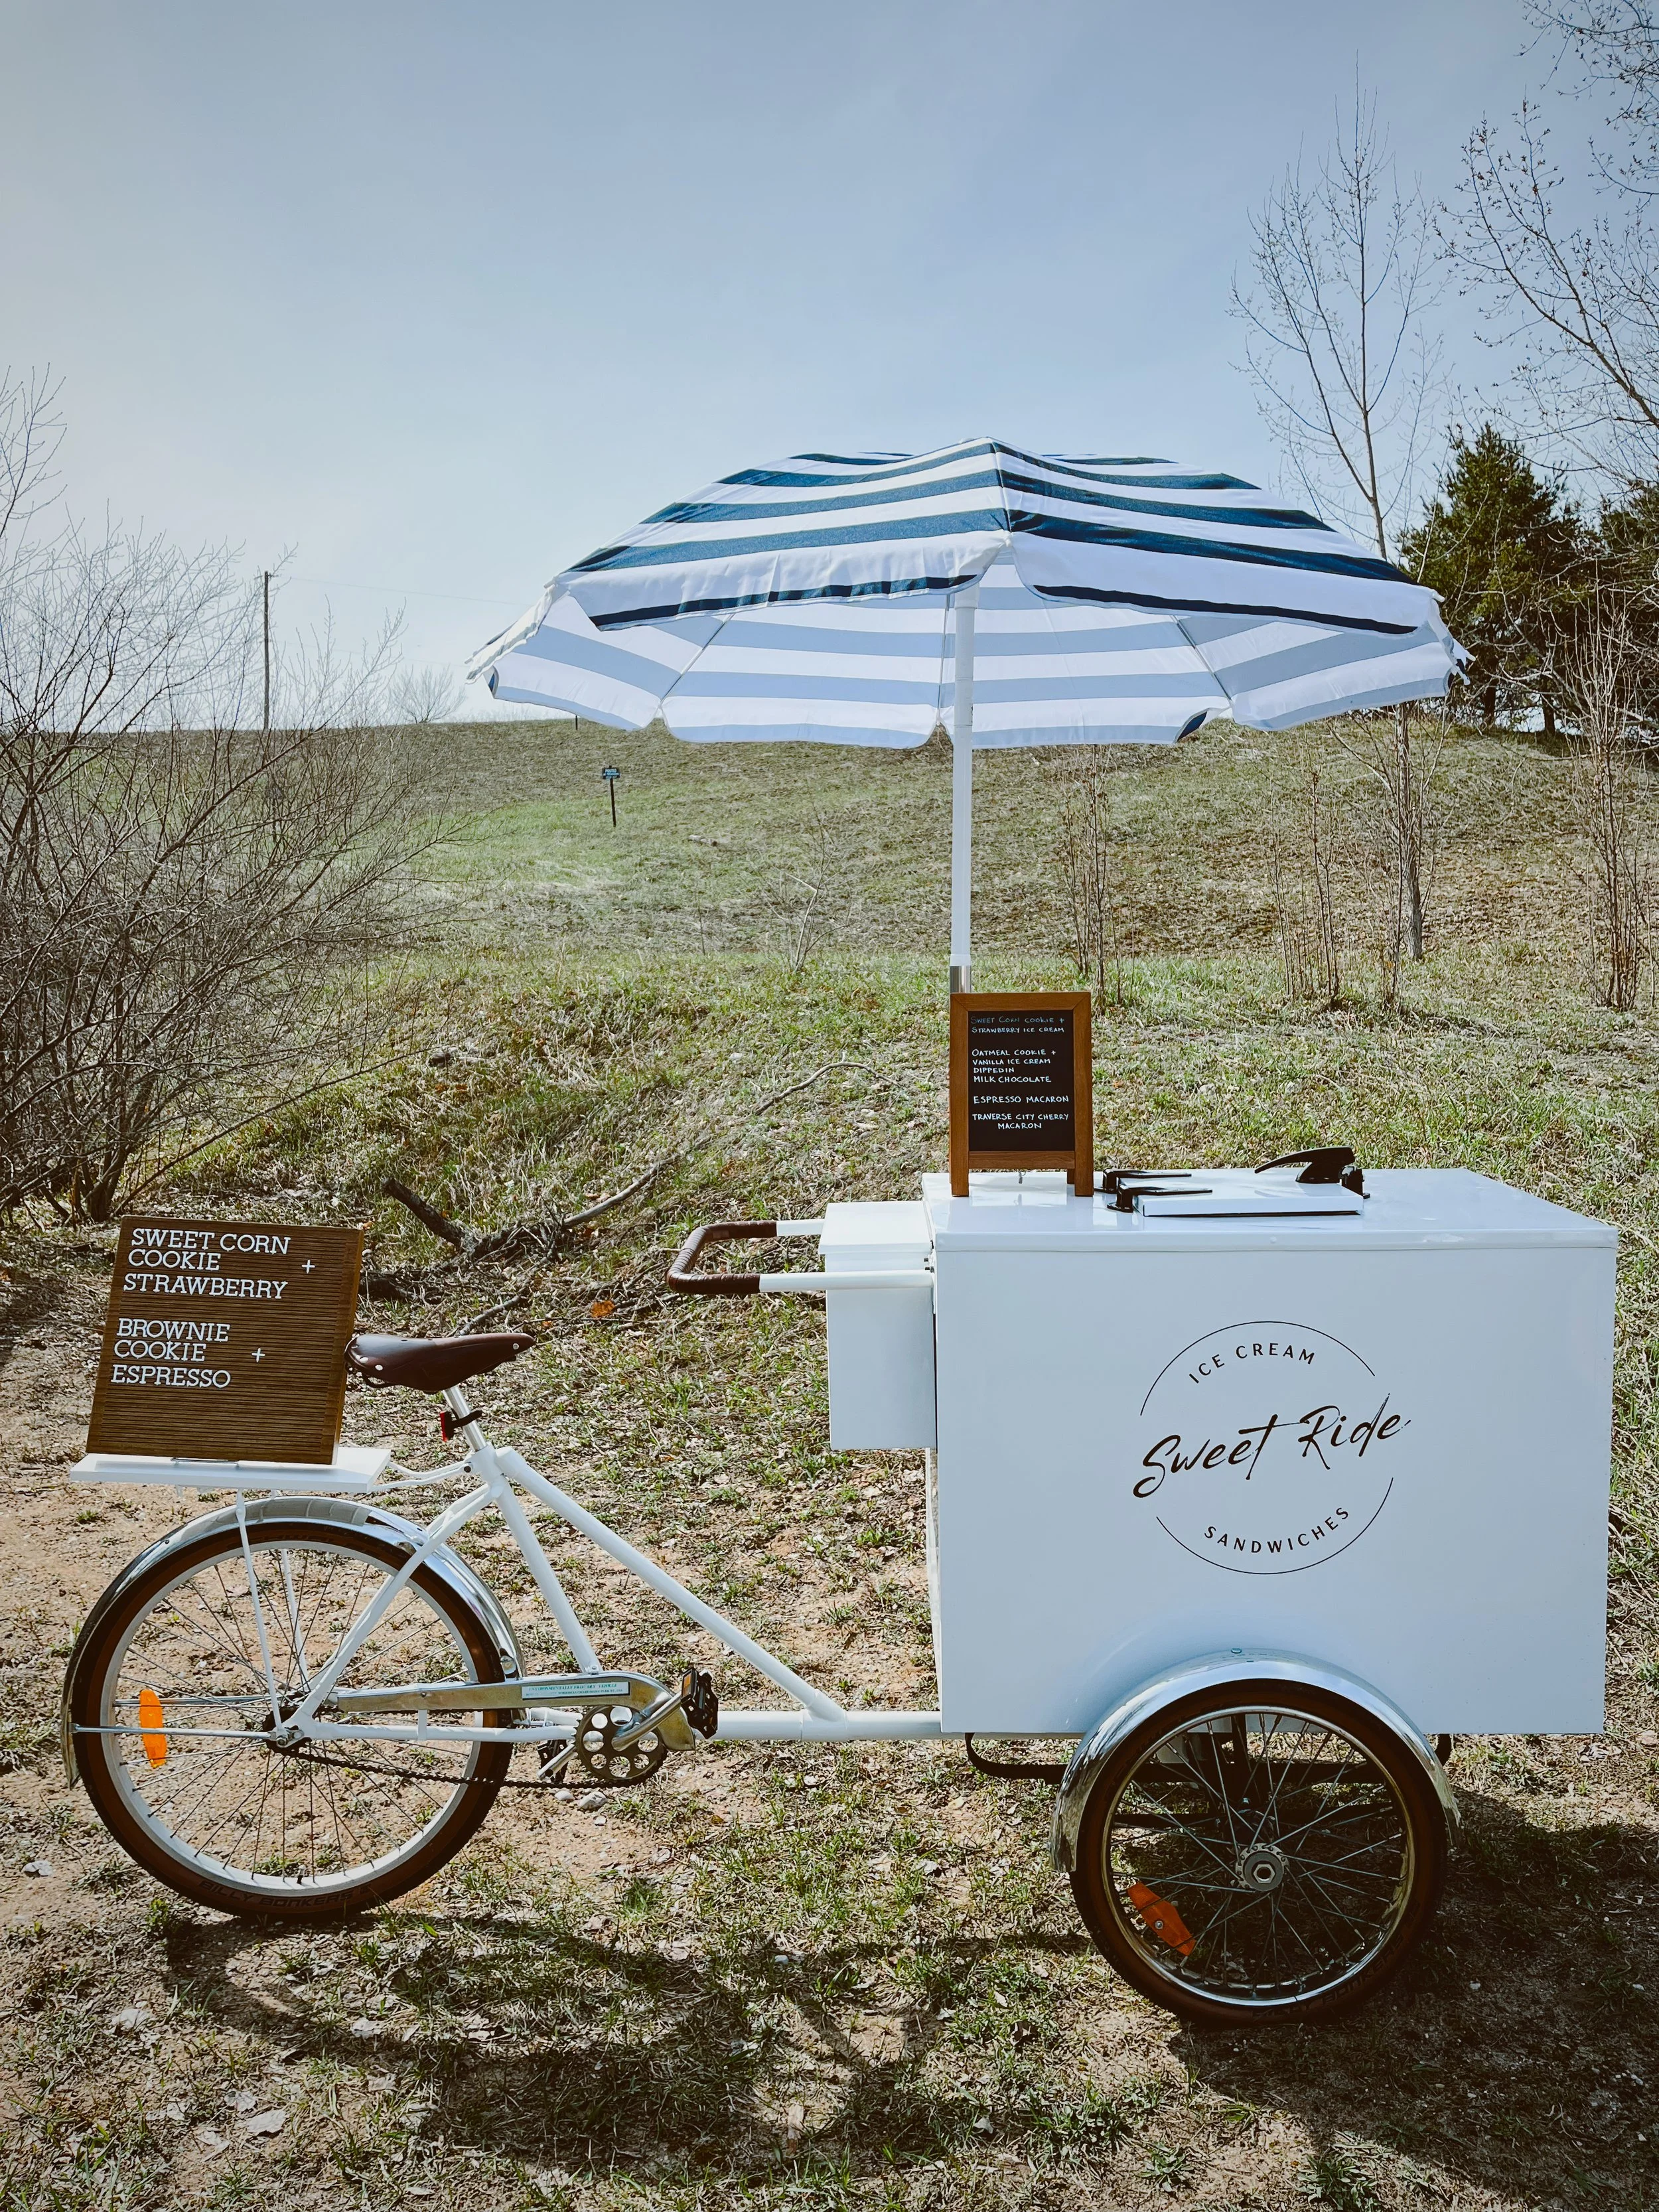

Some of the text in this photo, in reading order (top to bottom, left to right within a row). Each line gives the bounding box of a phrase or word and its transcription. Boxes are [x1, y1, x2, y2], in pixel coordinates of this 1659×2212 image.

[131, 1228, 291, 1254] SWEET CORN
[128, 1248, 315, 1274] COOKIE +
[123, 1274, 288, 1299] STRAWBERRY
[117, 1318, 230, 1341] BROWNIE
[114, 1340, 265, 1362] COOKIE +
[1189, 1343, 1314, 1383] ICE CREAM
[111, 1364, 230, 1388] ESPRESSO
[1133, 1393, 1411, 1498] Sweet Ride
[1204, 1507, 1349, 1553] SANDWICHES
[199, 1880, 354, 1907] BILLY BONKERS
